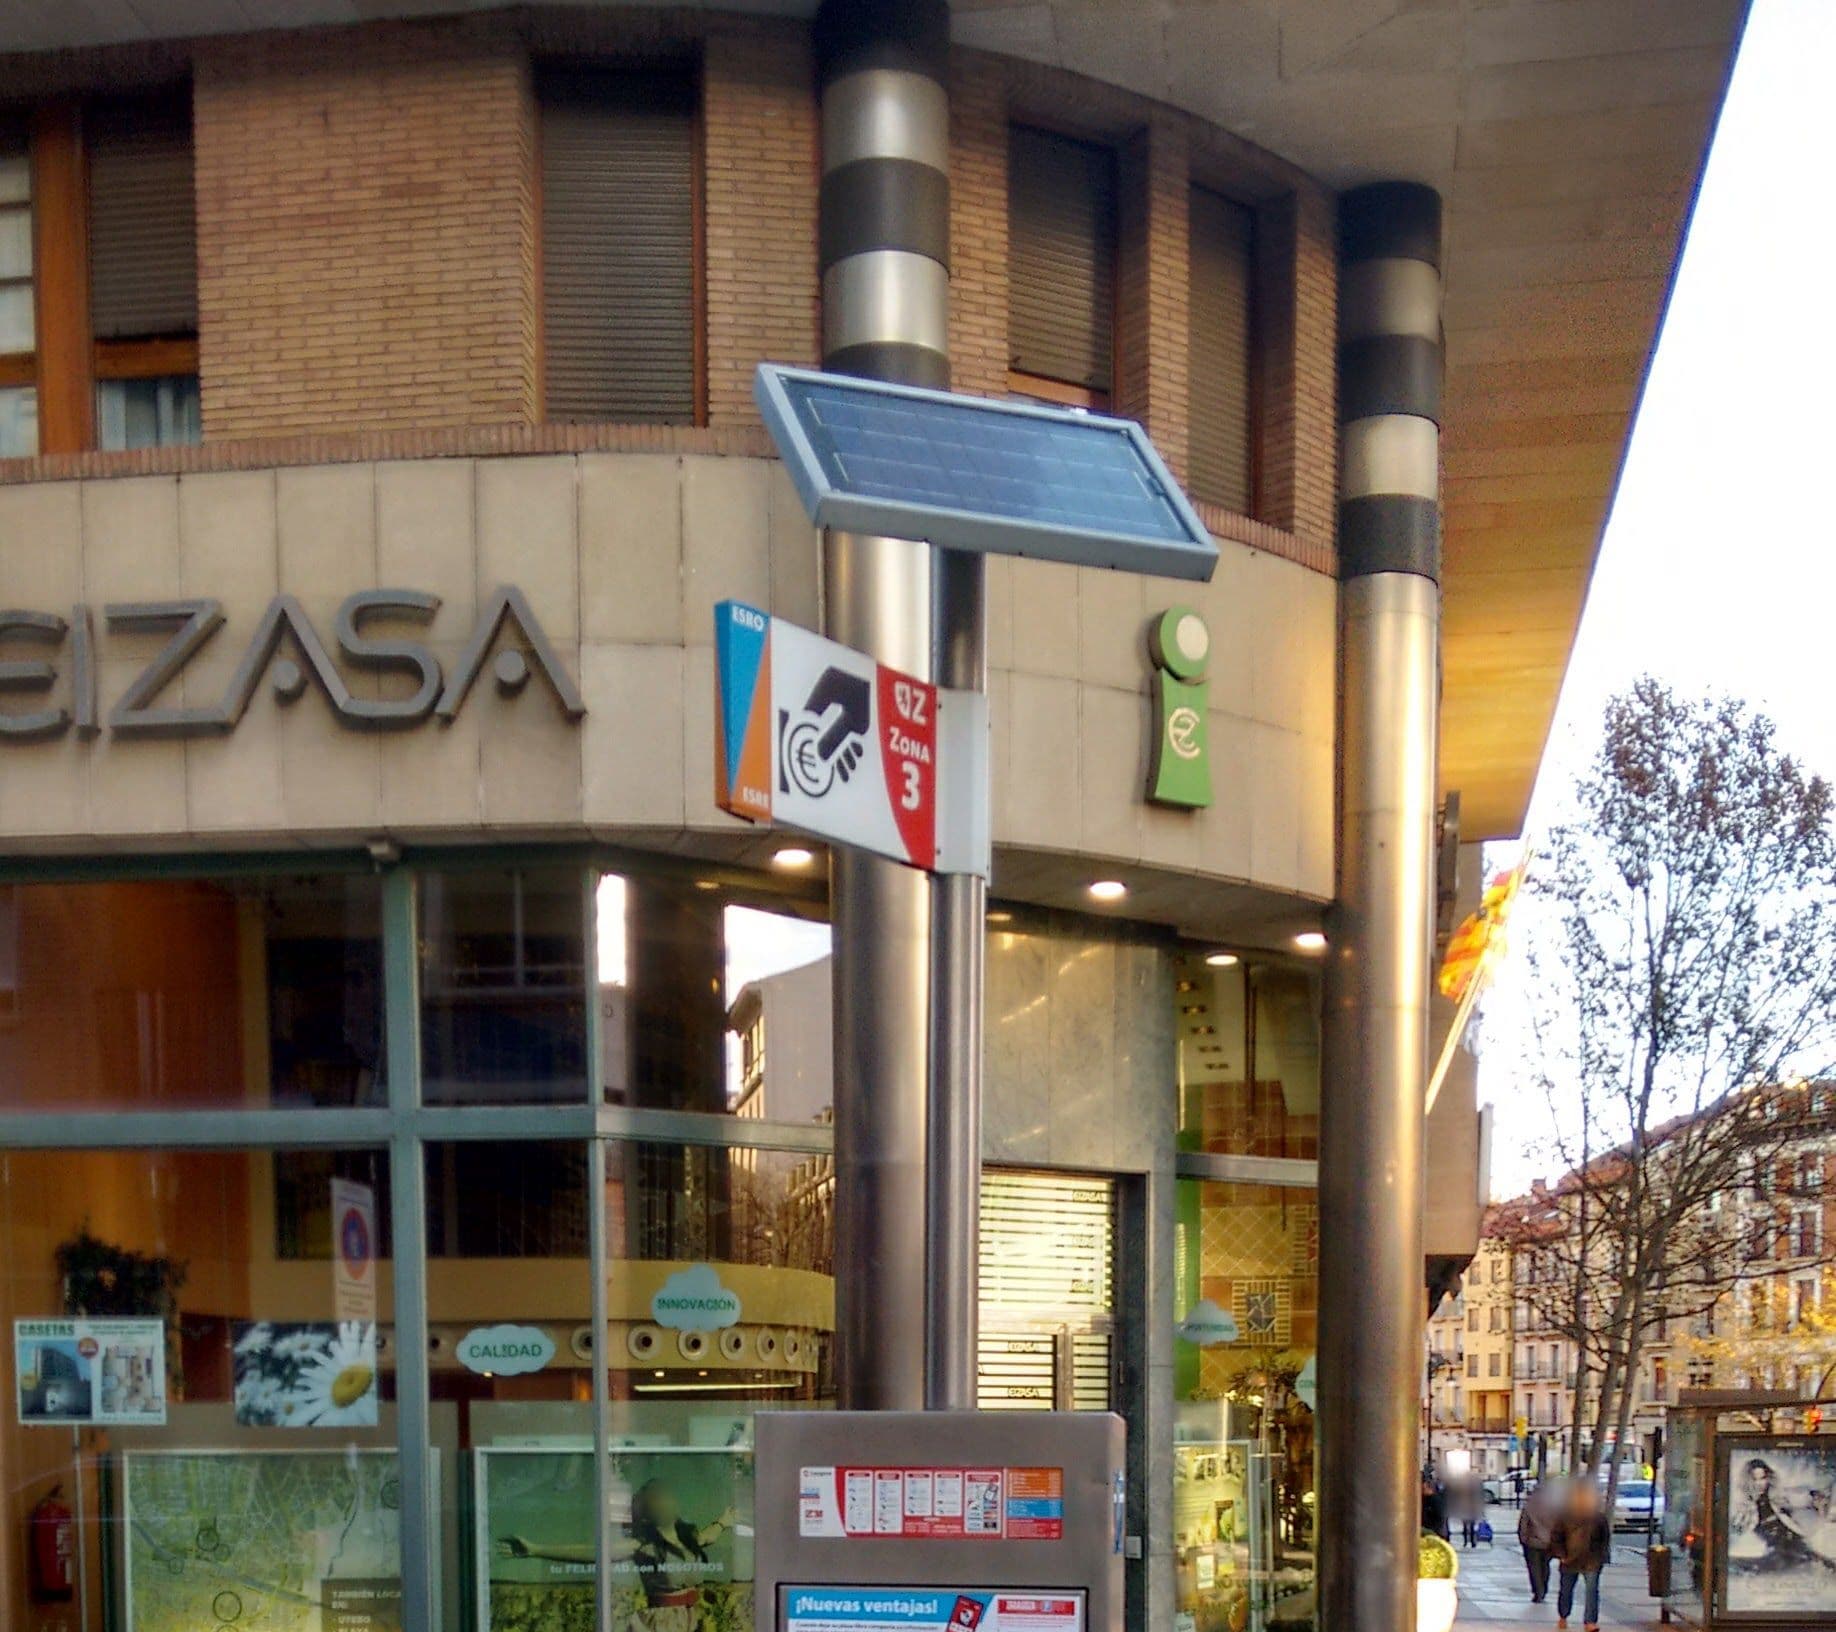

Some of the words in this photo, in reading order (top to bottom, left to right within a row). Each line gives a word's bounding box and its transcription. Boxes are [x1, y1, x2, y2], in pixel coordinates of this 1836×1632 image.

[889, 726, 930, 764] ZONA
[901, 761, 921, 811] 3
[469, 1343, 543, 1358] CALIDAD
[657, 1562, 724, 1573] NOSOTROS
[795, 1596, 861, 1615] ¡Nuevas
[863, 1599, 939, 1617] ventajas!
